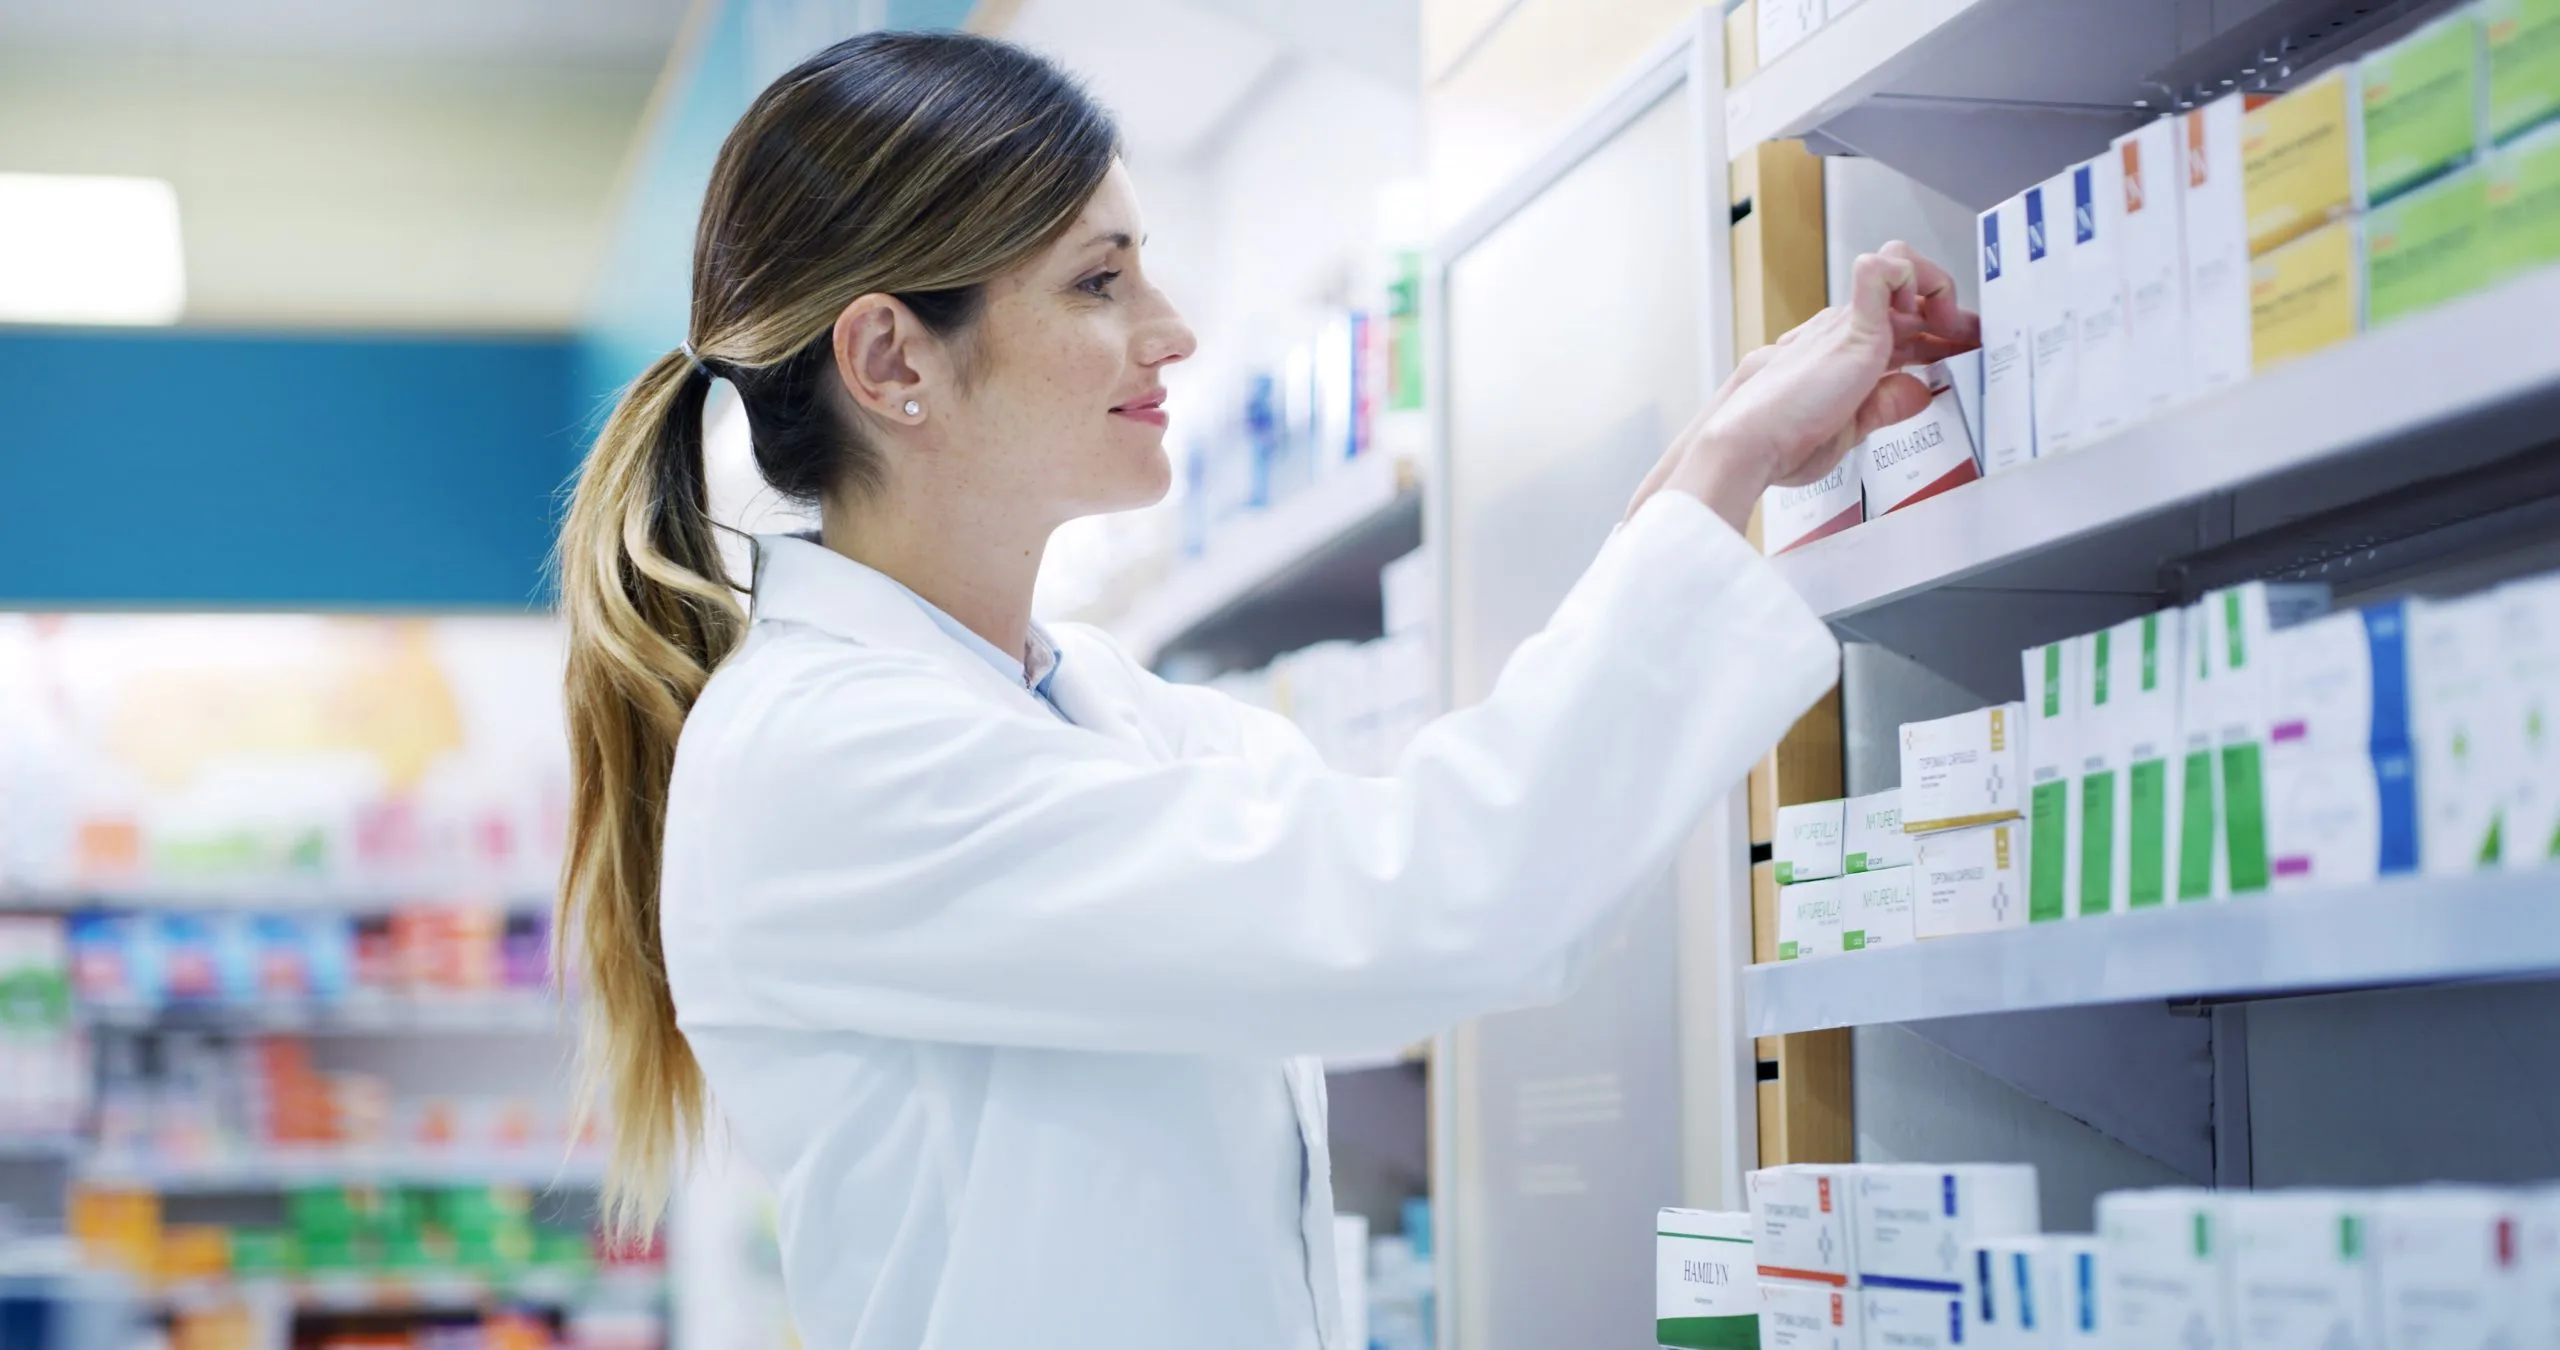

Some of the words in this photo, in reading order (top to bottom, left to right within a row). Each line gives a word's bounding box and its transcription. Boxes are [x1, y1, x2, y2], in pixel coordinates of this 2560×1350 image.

[2076, 202, 2093, 235] N
[2028, 221, 2045, 253] N
[1984, 242, 1999, 274] N
[1684, 1259, 1729, 1286] HAMILYN
